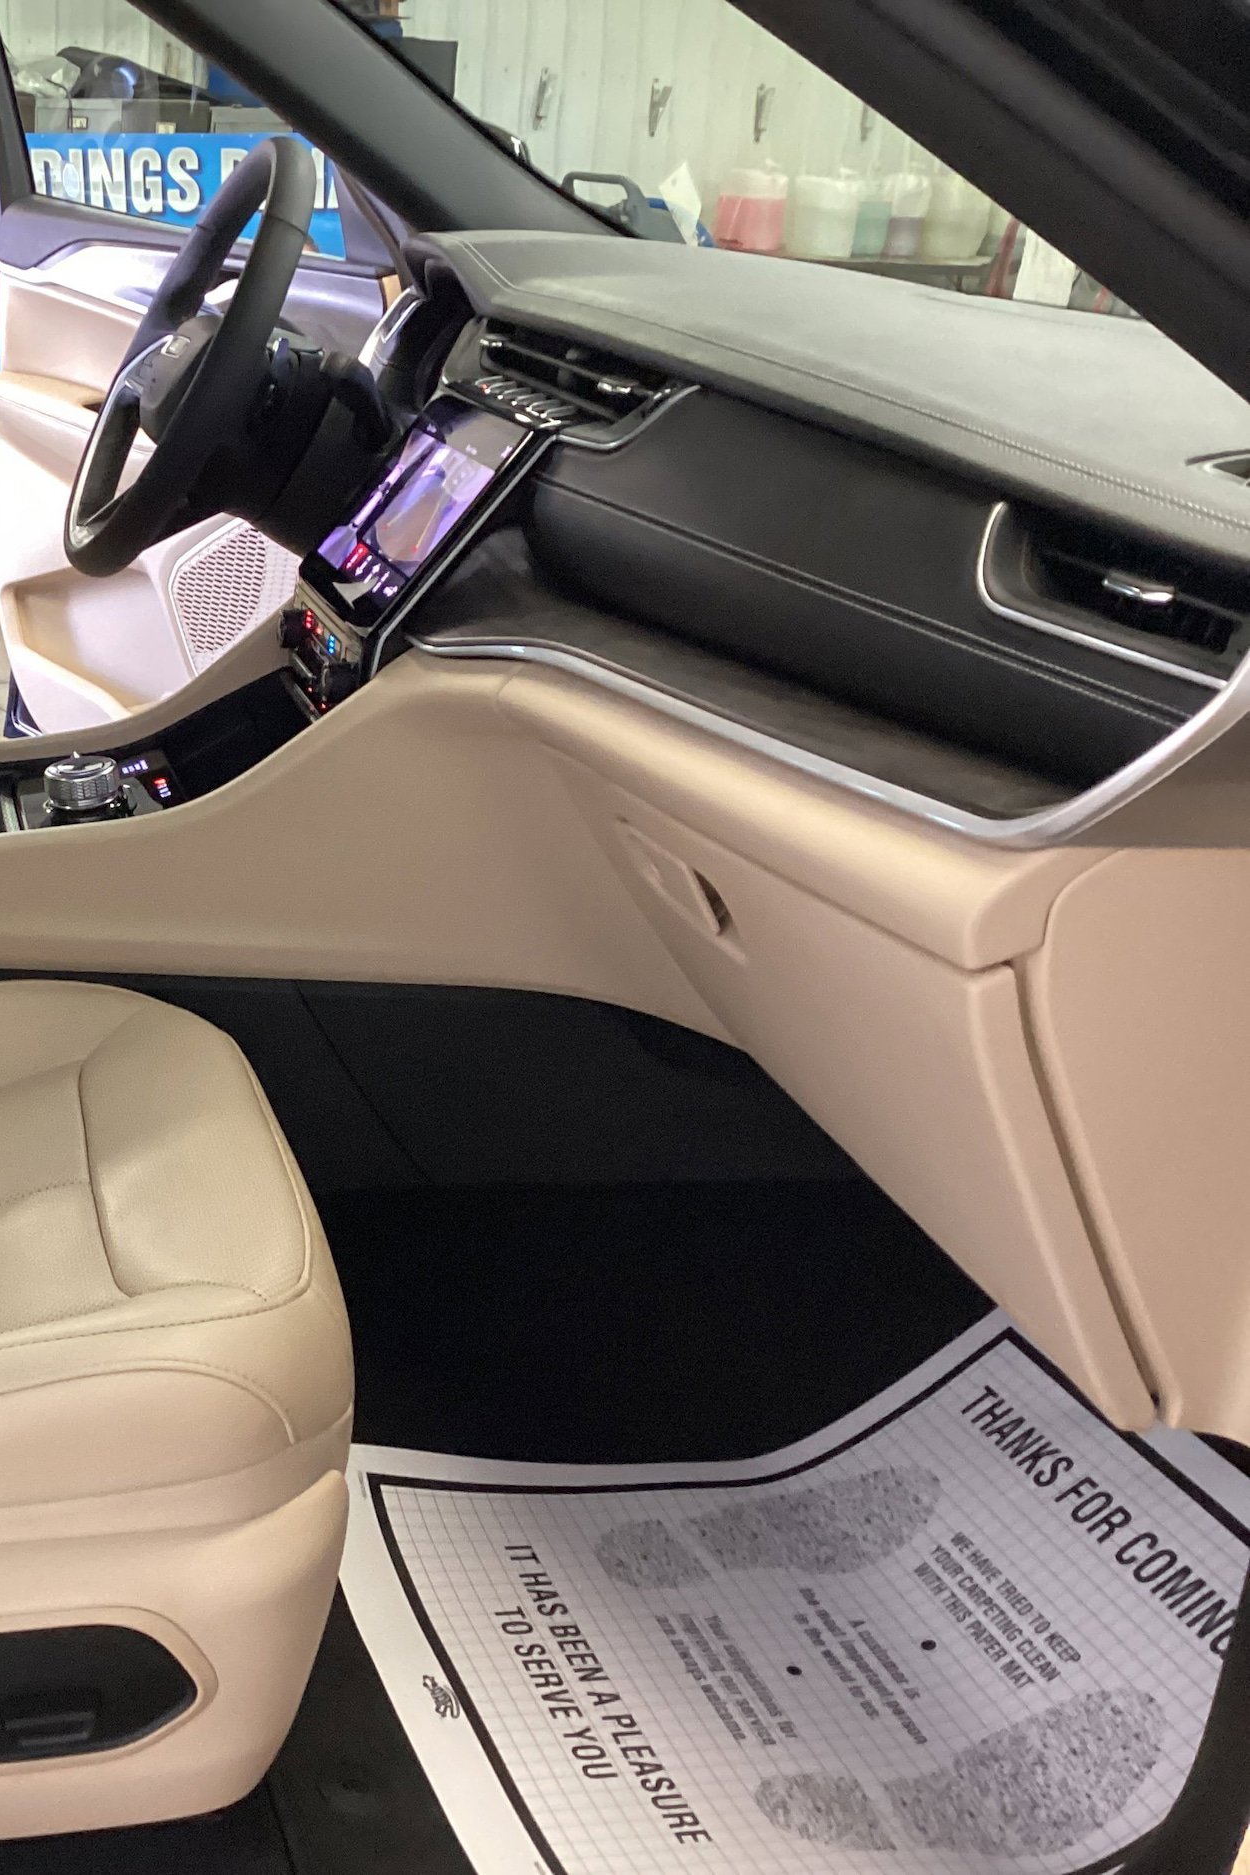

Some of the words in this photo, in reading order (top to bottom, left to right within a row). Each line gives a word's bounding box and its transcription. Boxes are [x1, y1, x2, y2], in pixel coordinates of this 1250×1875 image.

[961, 1385, 1074, 1487] THANKS
[1054, 1476, 1132, 1544] FOR
[505, 1545, 540, 1564] IT
[519, 1572, 569, 1617] HAS
[932, 1544, 964, 1578] YOUR
[958, 1576, 1023, 1641] CARPETING
[1017, 1638, 1061, 1682] CLEAN
[951, 1532, 974, 1553] WE
[967, 1550, 1002, 1583] HAVE
[996, 1578, 1034, 1616] TRIED
[1028, 1613, 1051, 1634] TO
[1045, 1631, 1082, 1662] KEEP
[549, 1623, 610, 1682] BEEN
[914, 1562, 948, 1596] WITH
[942, 1590, 973, 1623] THIS
[966, 1620, 1007, 1662] PAPER
[1000, 1659, 1034, 1688] MAT
[495, 1606, 533, 1635] TO
[514, 1643, 583, 1720] SERVE
[563, 1727, 618, 1780] YOU
[587, 1690, 621, 1706] A
[601, 1714, 712, 1844] PLEASURE
